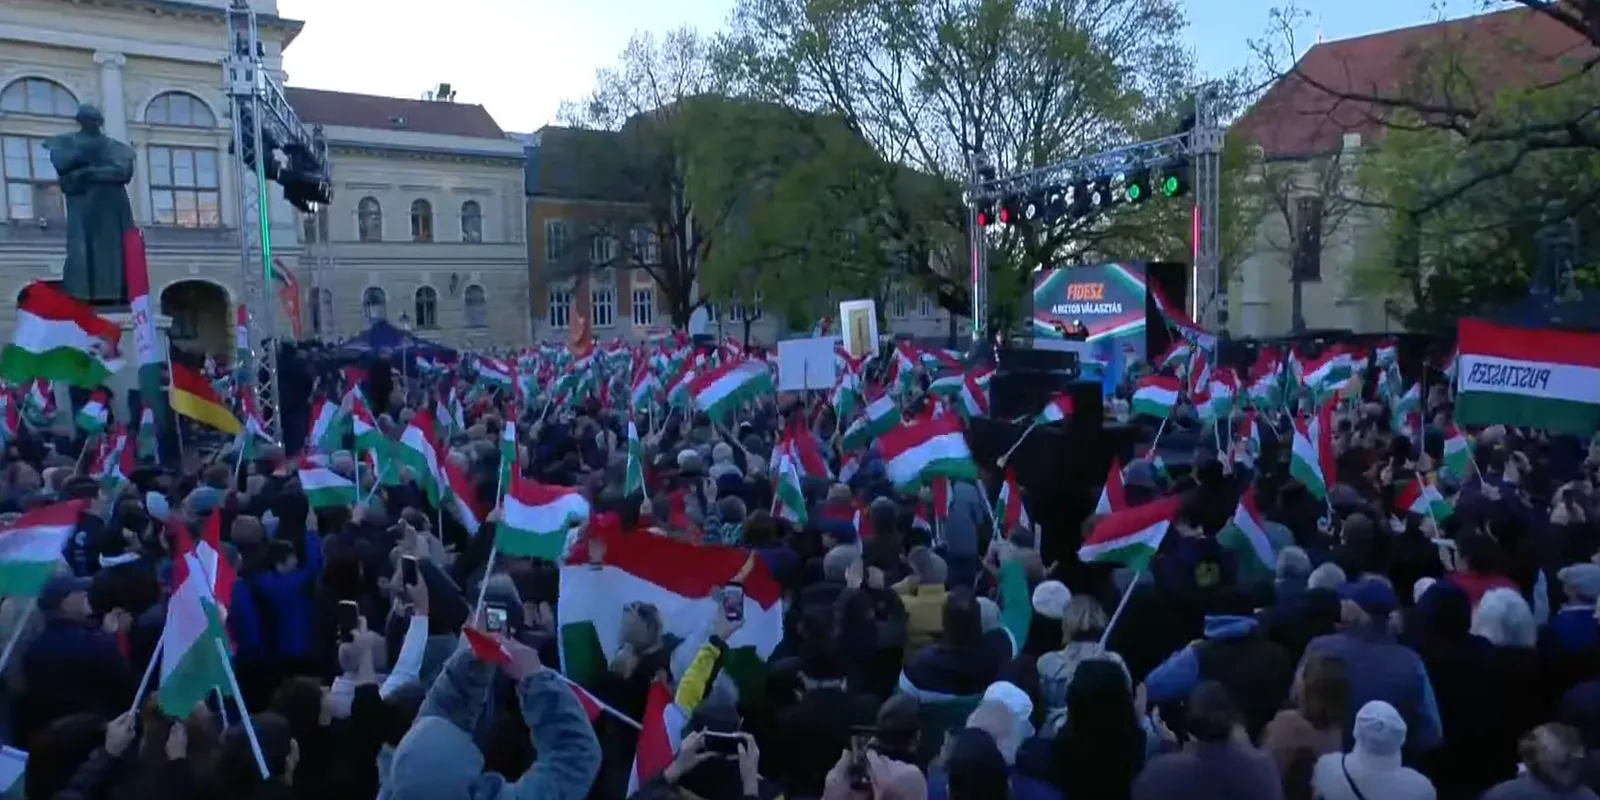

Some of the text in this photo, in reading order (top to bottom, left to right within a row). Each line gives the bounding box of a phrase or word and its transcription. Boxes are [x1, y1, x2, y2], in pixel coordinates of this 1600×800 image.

[1067, 283, 1104, 300] FIDESZ
[1057, 304, 1080, 314] BIZTOS
[1080, 301, 1122, 314] VÁLASZTÁS
